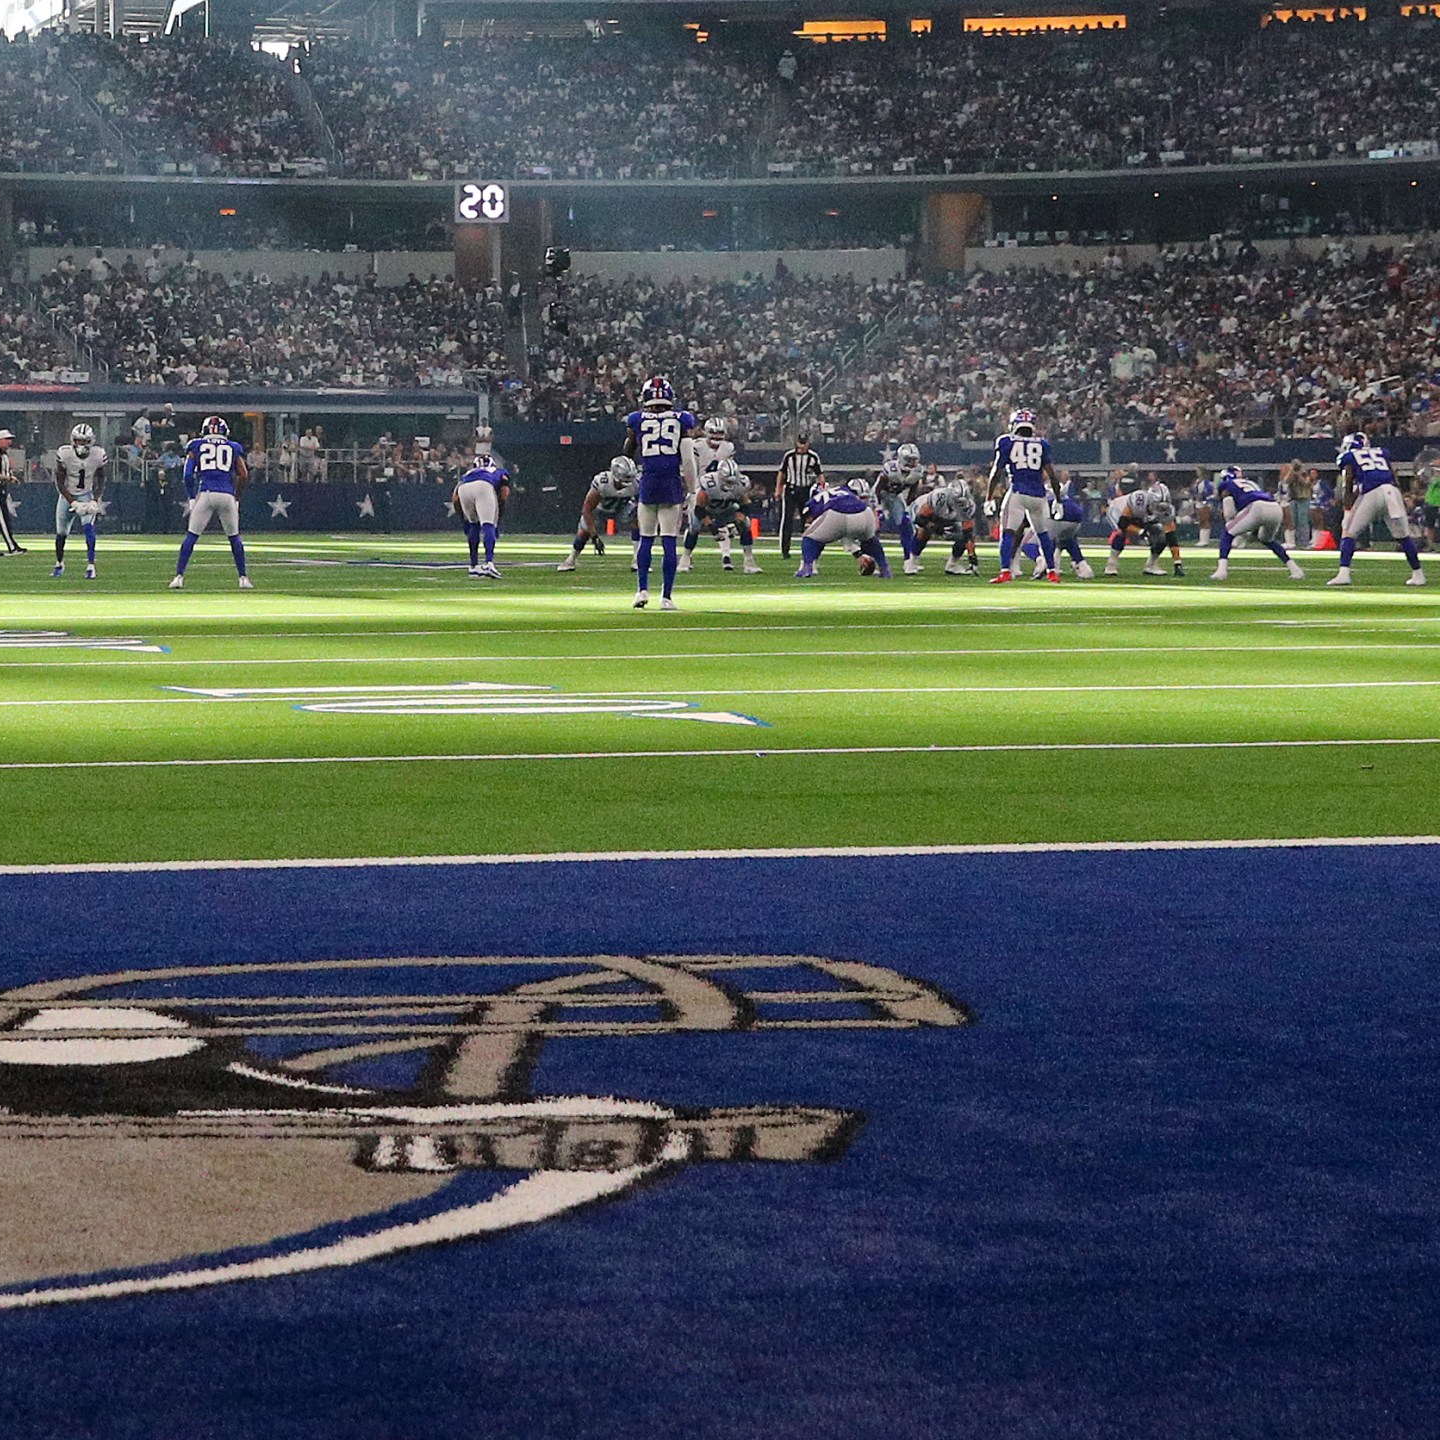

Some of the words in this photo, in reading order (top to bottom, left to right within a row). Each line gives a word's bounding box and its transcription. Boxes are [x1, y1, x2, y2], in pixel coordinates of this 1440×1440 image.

[459, 183, 505, 219] 20
[640, 418, 682, 457] 29
[199, 443, 233, 472] 20
[1009, 441, 1043, 471] 48
[1352, 448, 1390, 471] 55
[76, 469, 85, 489] 1
